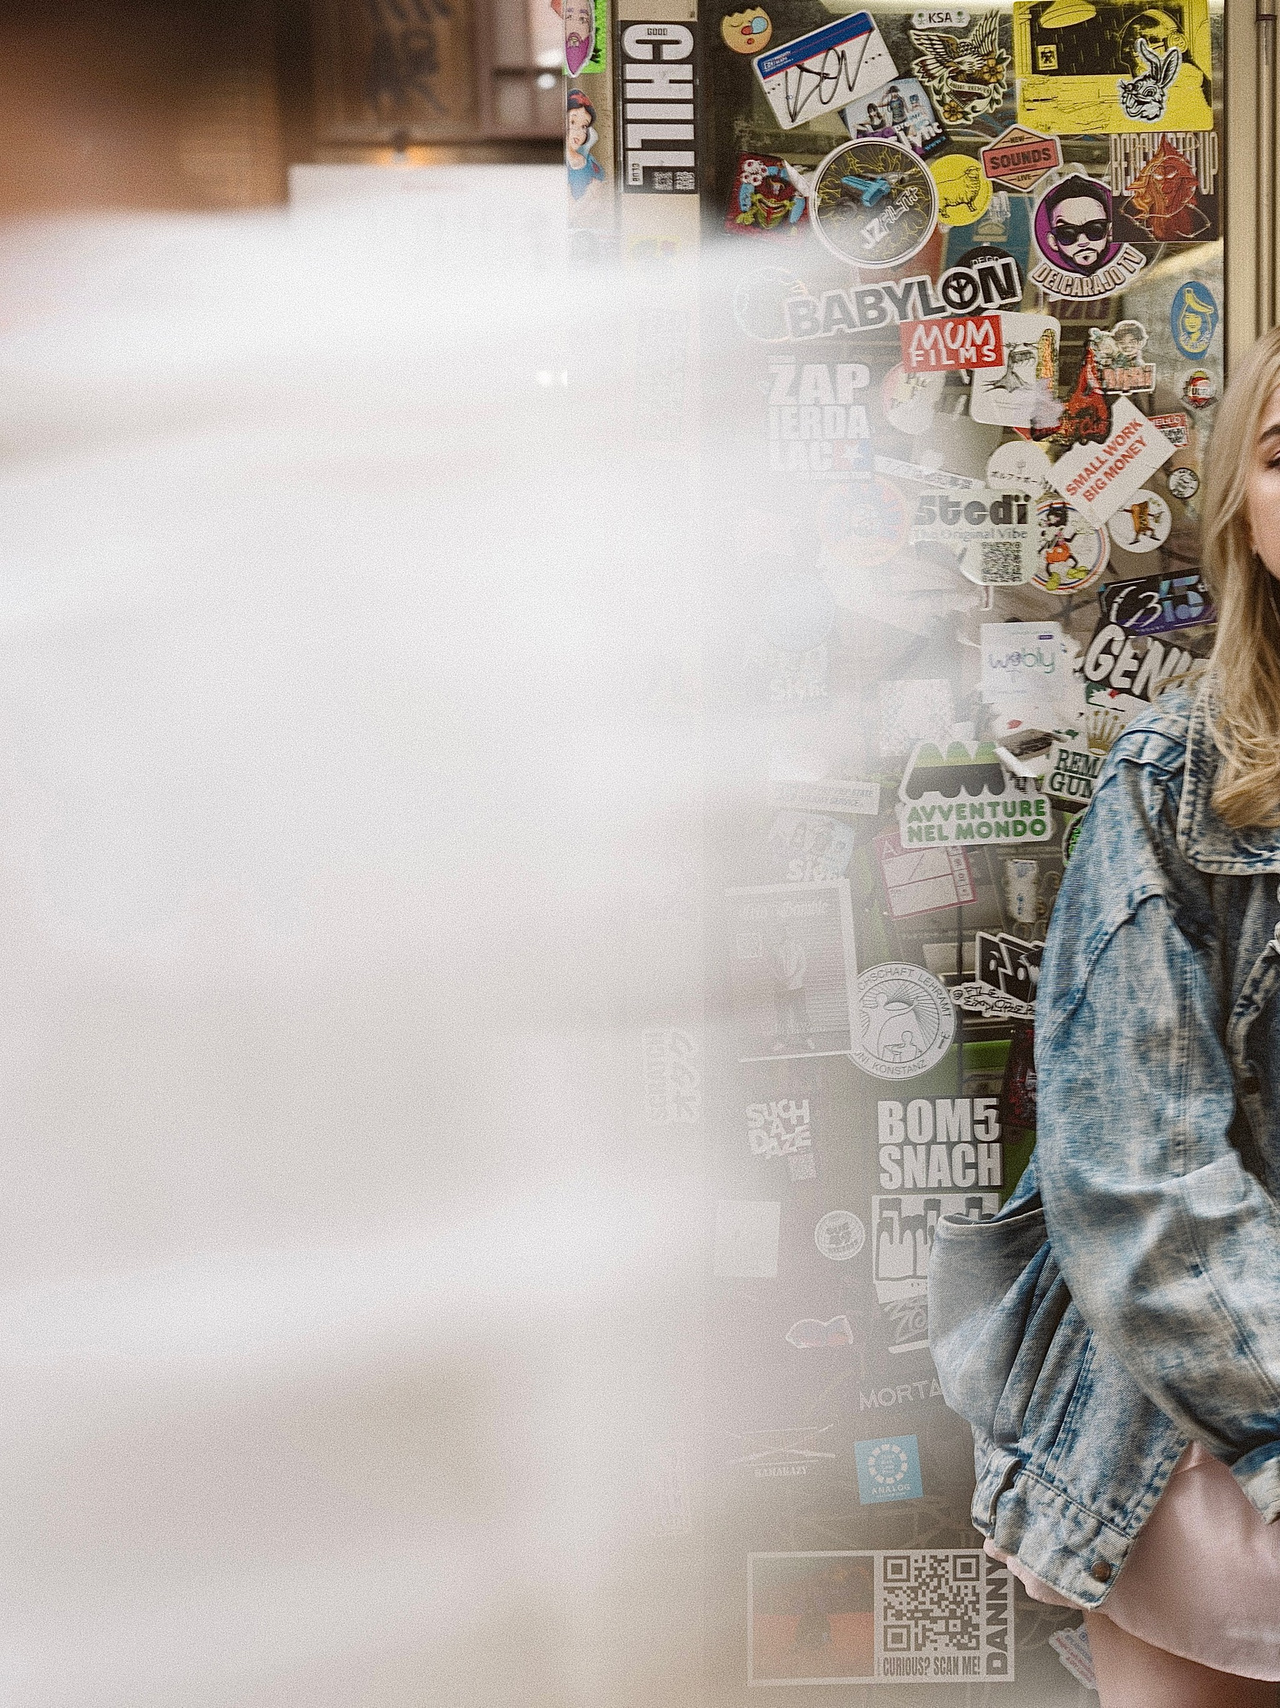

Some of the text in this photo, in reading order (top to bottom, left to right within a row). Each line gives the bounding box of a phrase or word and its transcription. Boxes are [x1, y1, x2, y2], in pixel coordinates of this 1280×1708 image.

[928, 12, 952, 24] KSA
[647, 28, 668, 36] GOOD
[622, 24, 695, 186] CHILL
[1010, 136, 1025, 144] NEW
[990, 148, 1051, 170] SOUNDS
[1032, 247, 1144, 297] DELCARAJO TV
[788, 261, 1018, 339] BABYLON
[909, 319, 996, 351] MUM
[910, 347, 997, 368] FILMS
[1066, 456, 1108, 496] SMALL
[1103, 418, 1144, 457] WORK
[1082, 435, 1148, 503] BIG MONEY
[907, 798, 1047, 823] AVVENTURE
[907, 818, 1047, 843] NEL MONDO
[857, 968, 916, 993] CHSCHAFT
[872, 1059, 927, 1075] KONSTANZ
[746, 1099, 810, 1129] SUCH
[879, 1143, 1004, 1190] SNACH
[872, 1484, 911, 1495] ANALOG
[985, 1554, 1009, 1676] DANNY
[883, 1656, 981, 1677] CURIOUS? SCAN ME!
